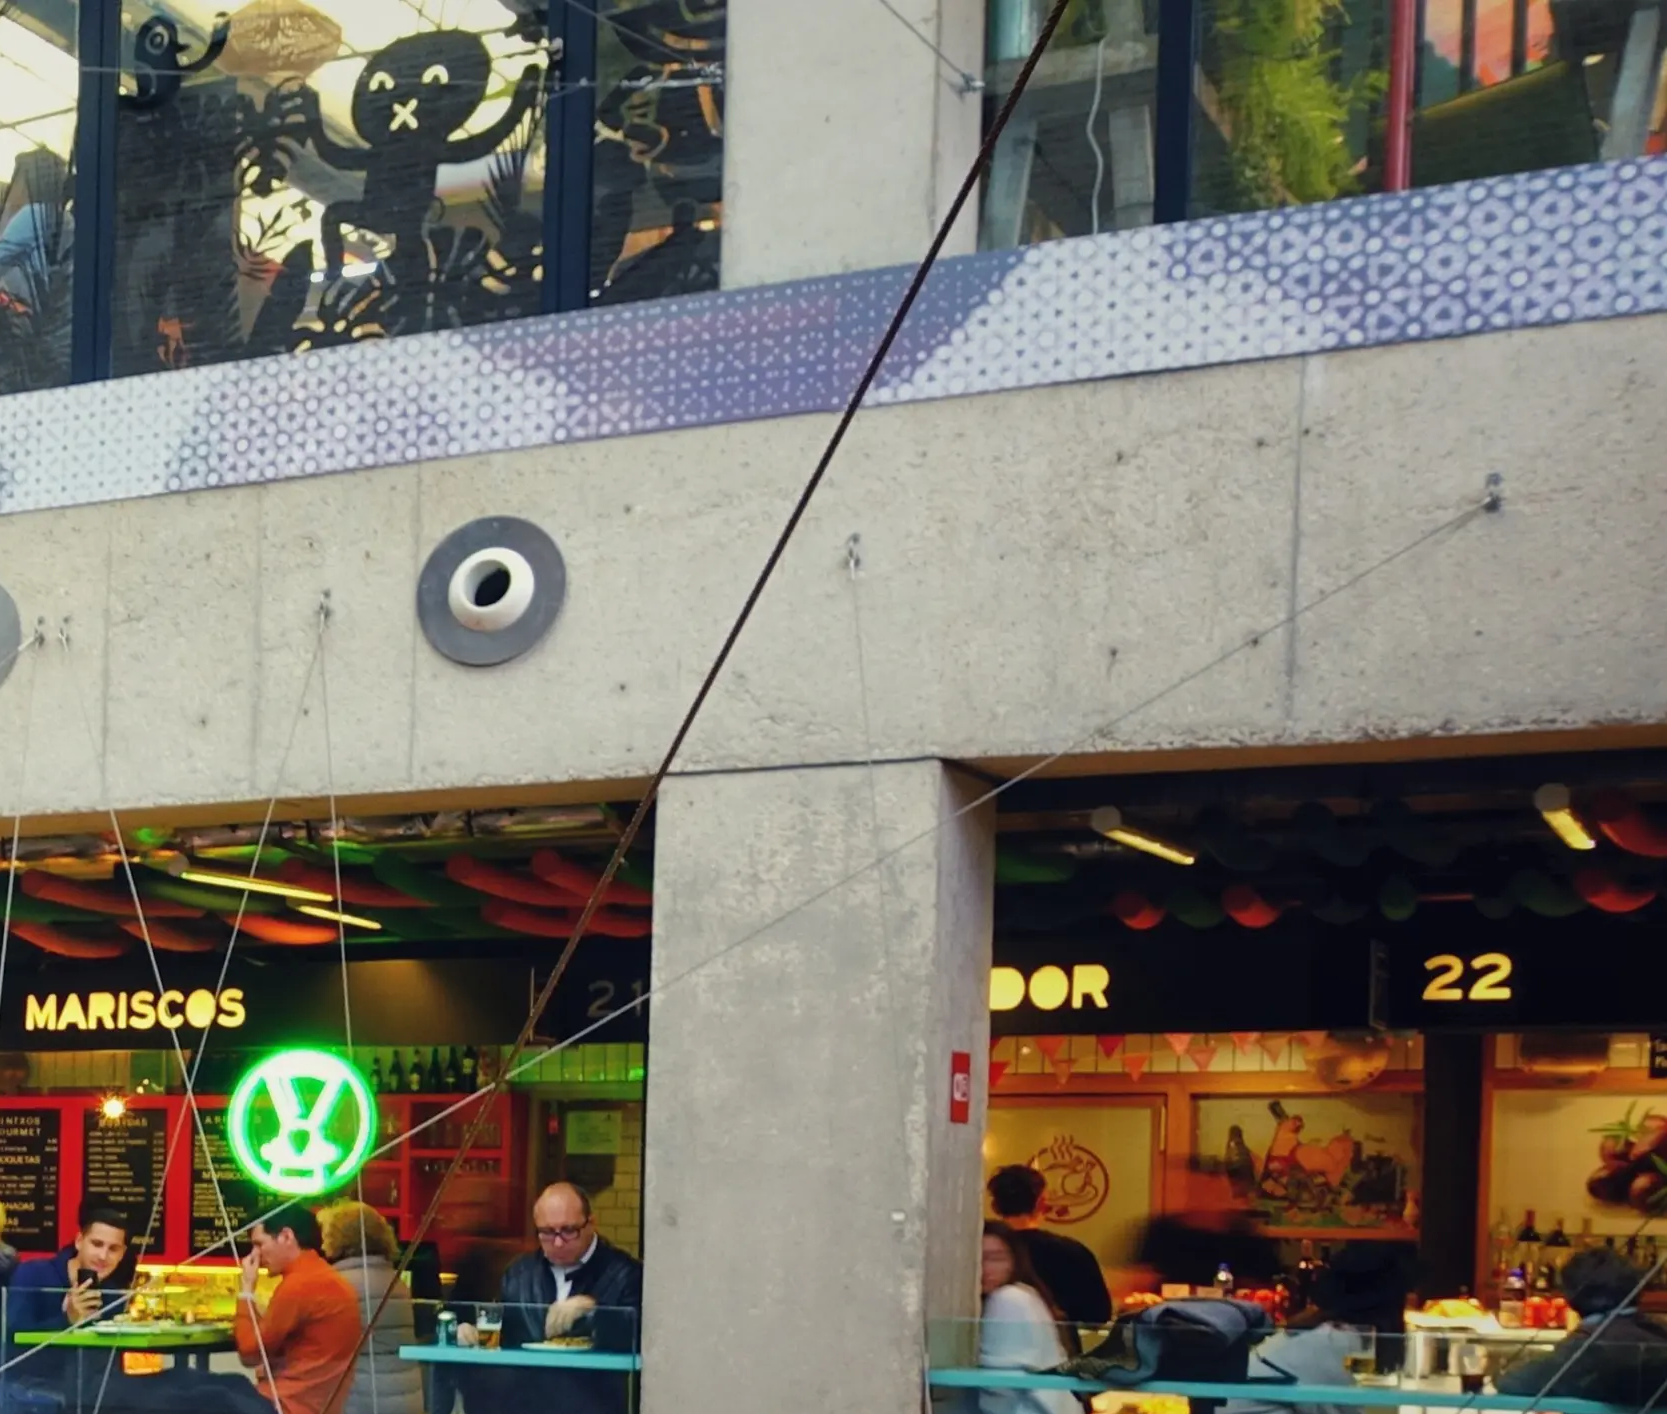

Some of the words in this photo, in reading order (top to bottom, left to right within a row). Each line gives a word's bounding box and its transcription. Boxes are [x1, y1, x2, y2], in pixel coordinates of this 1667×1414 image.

[989, 964, 1110, 1011] DOR
[1422, 952, 1512, 1000] 22
[25, 988, 245, 1031] MARISCOS
[587, 980, 643, 1018] 21
